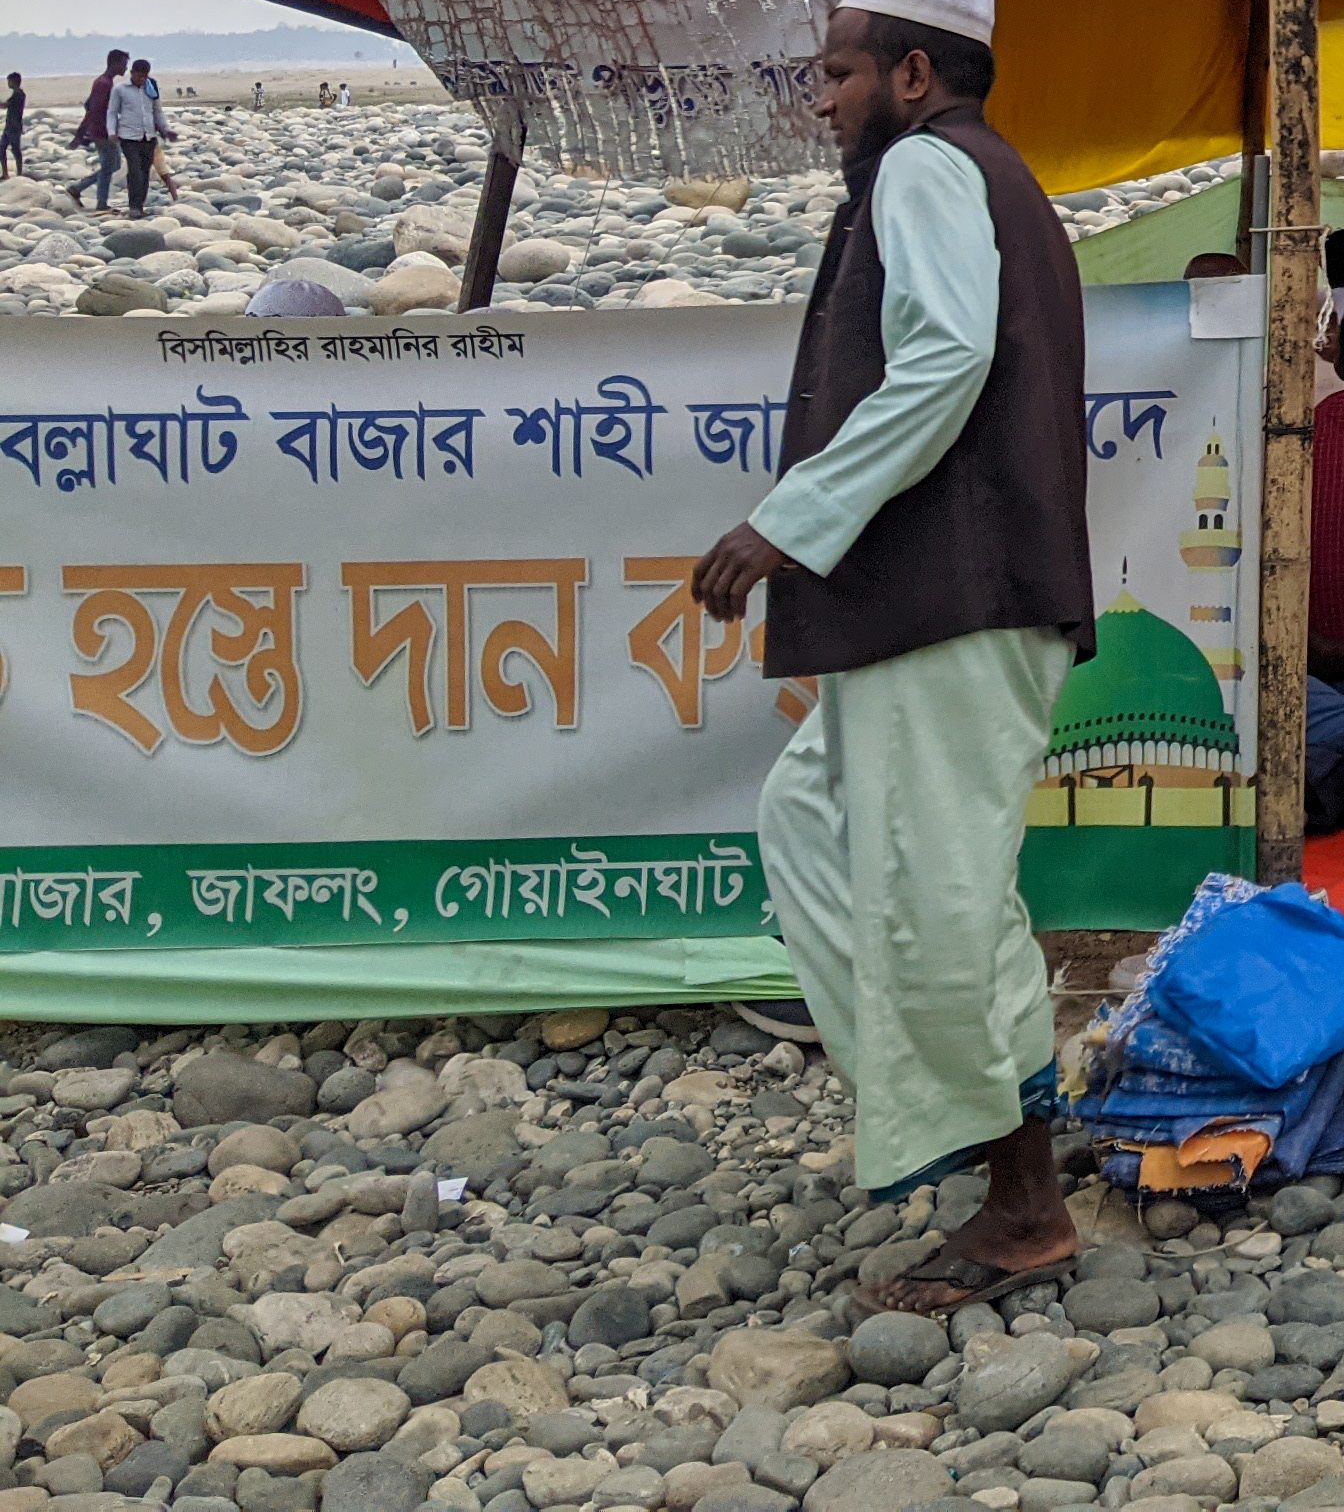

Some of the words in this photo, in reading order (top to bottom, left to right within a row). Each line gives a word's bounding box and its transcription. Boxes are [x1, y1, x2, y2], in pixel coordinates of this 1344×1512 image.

[317, 328, 441, 361] রাহমানির
[447, 325, 526, 360] রাহীম
[0, 384, 251, 494] বল্লাঘাট
[270, 400, 487, 485] বাজার
[504, 374, 669, 480] শাহী
[62, 562, 308, 759] হস্তে
[340, 557, 591, 738] দান
